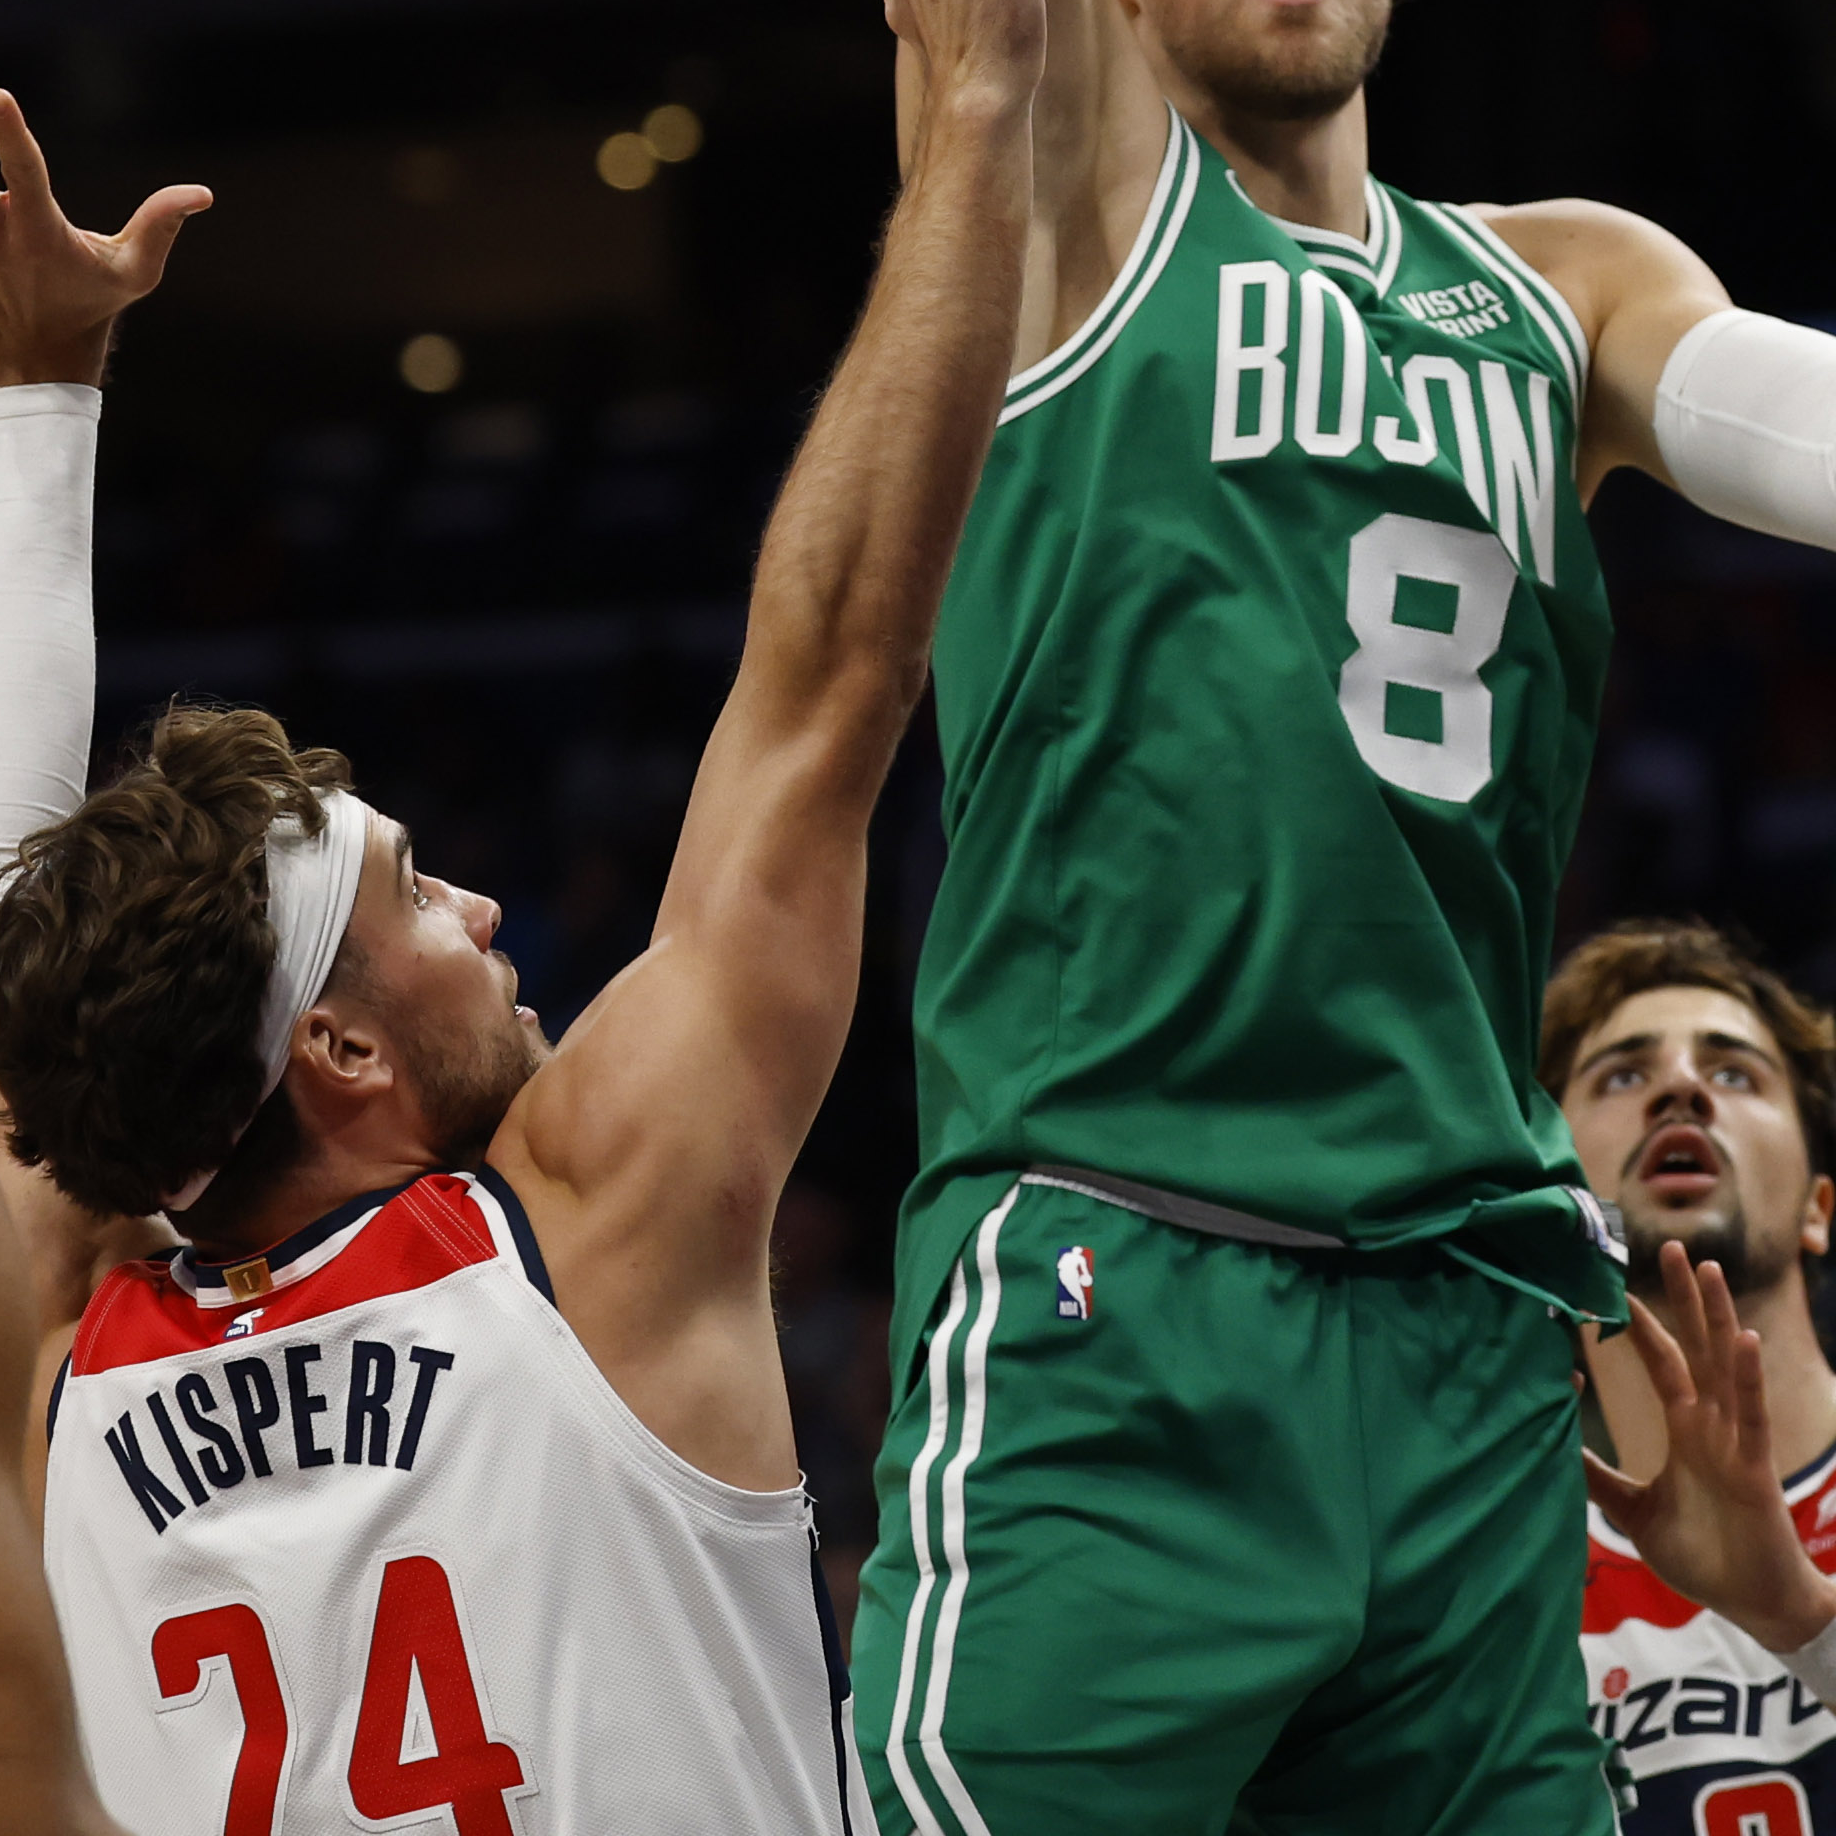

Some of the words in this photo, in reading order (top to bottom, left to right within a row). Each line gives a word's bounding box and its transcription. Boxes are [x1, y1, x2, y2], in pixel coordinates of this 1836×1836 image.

[1397, 278, 1502, 322] VISTA
[1337, 512, 1520, 804] 8
[104, 1339, 455, 1535] KISPERT
[151, 1554, 525, 1836] 24
[1588, 1666, 1824, 1751] izar
